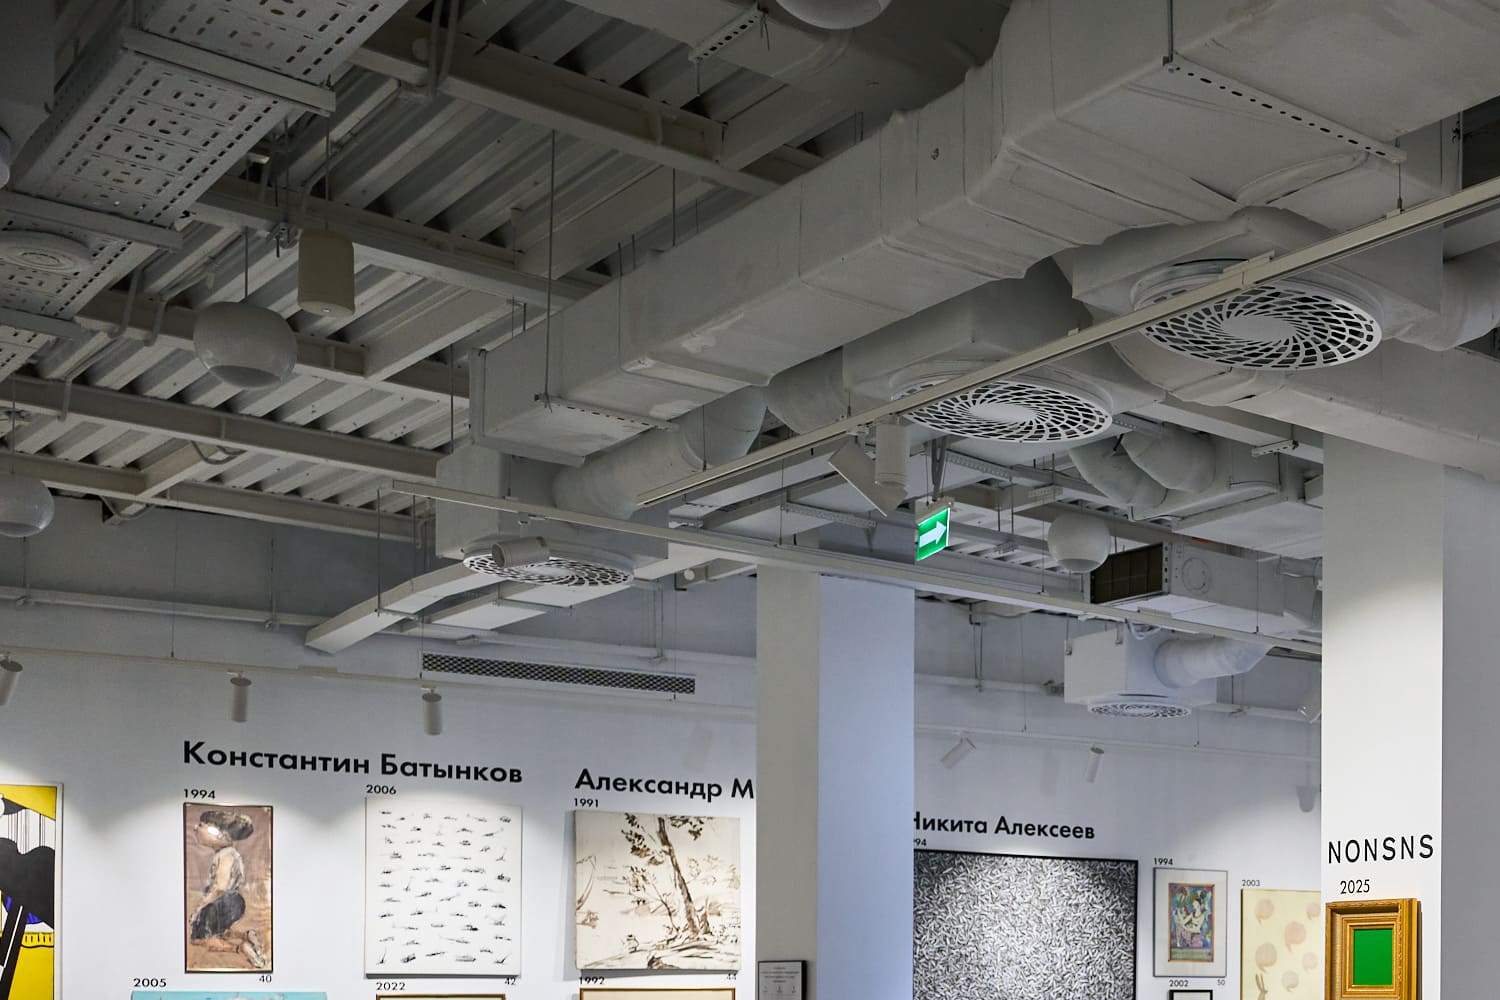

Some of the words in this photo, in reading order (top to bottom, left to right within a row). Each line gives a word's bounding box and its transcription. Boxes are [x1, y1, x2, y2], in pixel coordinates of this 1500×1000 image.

[183, 741, 370, 774] Константин
[380, 753, 523, 784] Батынков
[366, 785, 397, 795] 2006
[575, 768, 722, 802] Александр
[184, 789, 216, 800] 1994
[574, 798, 599, 808] 1991
[994, 816, 1095, 840] Алексеев
[914, 838, 927, 847] 94
[1328, 834, 1434, 864] NONSNS
[1153, 858, 1174, 866] 1994
[1241, 879, 1261, 888] 2003
[1340, 879, 1370, 895] 2025
[133, 978, 167, 988] 2005
[259, 974, 272, 983] 40
[504, 976, 517, 985] 42
[579, 976, 605, 985] 1992
[1169, 979, 1189, 987] 2002
[376, 982, 406, 991] 2022
